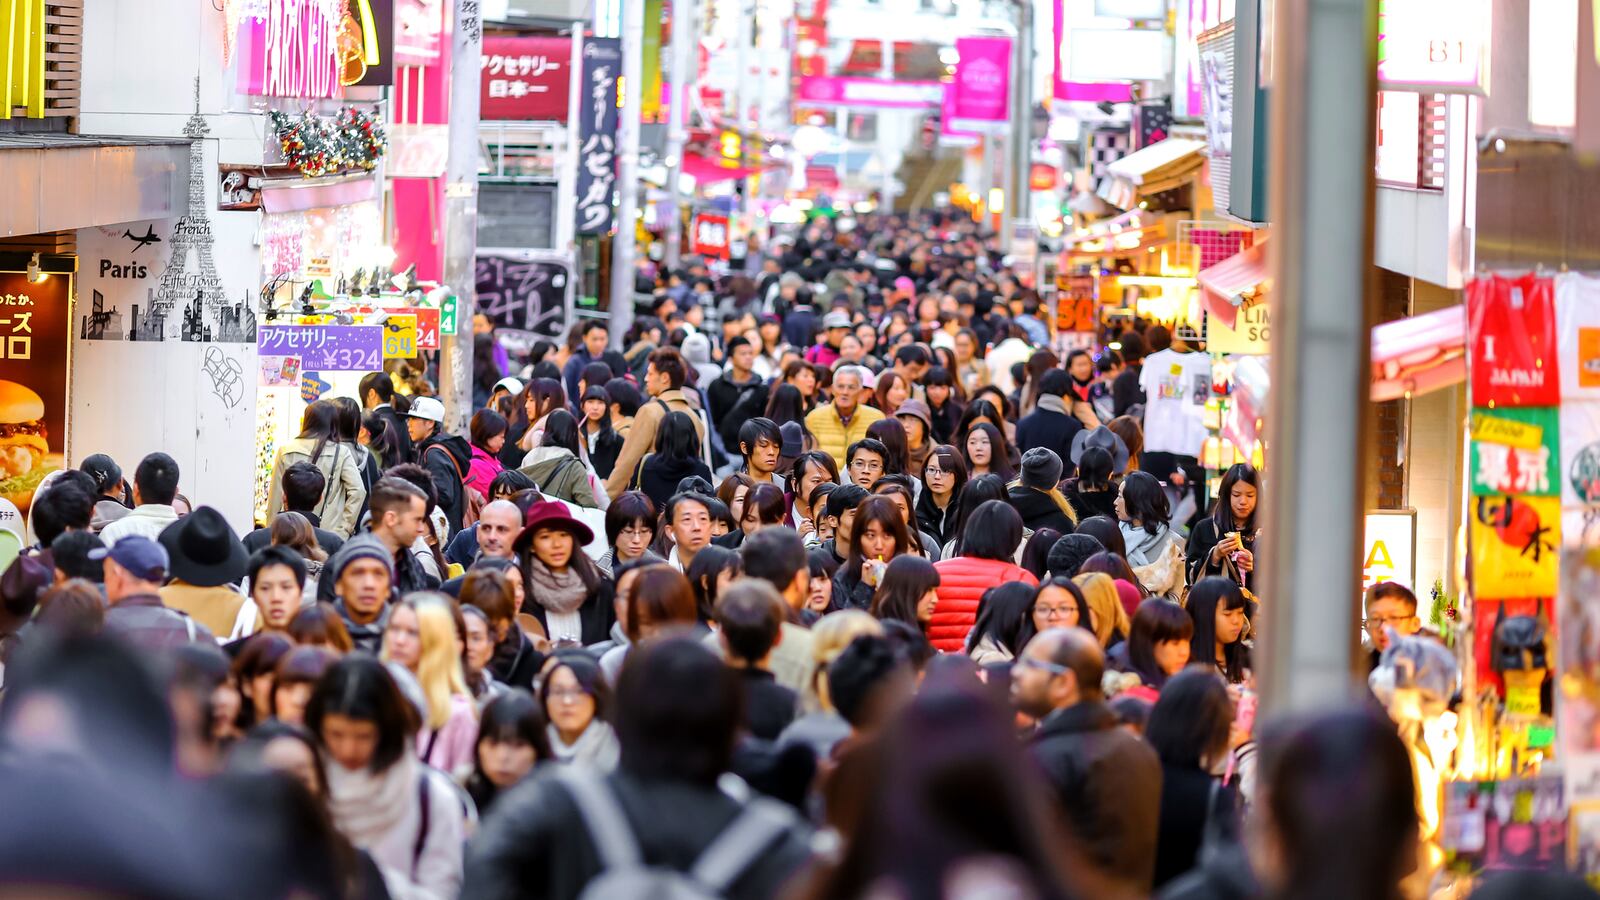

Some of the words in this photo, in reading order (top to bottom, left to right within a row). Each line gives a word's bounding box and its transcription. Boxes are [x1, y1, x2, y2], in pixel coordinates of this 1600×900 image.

[1429, 40, 1464, 63] B1
[489, 79, 548, 98] 日本一
[174, 220, 211, 235] French
[99, 259, 147, 279] Paris
[160, 272, 190, 289] Eiffel
[189, 274, 222, 287] Tower
[0, 336, 31, 359] ロ
[260, 328, 337, 349] アクセサリー
[323, 348, 380, 370] ¥324
[1490, 368, 1545, 386] JAPAN
[1476, 443, 1550, 493] 東京
